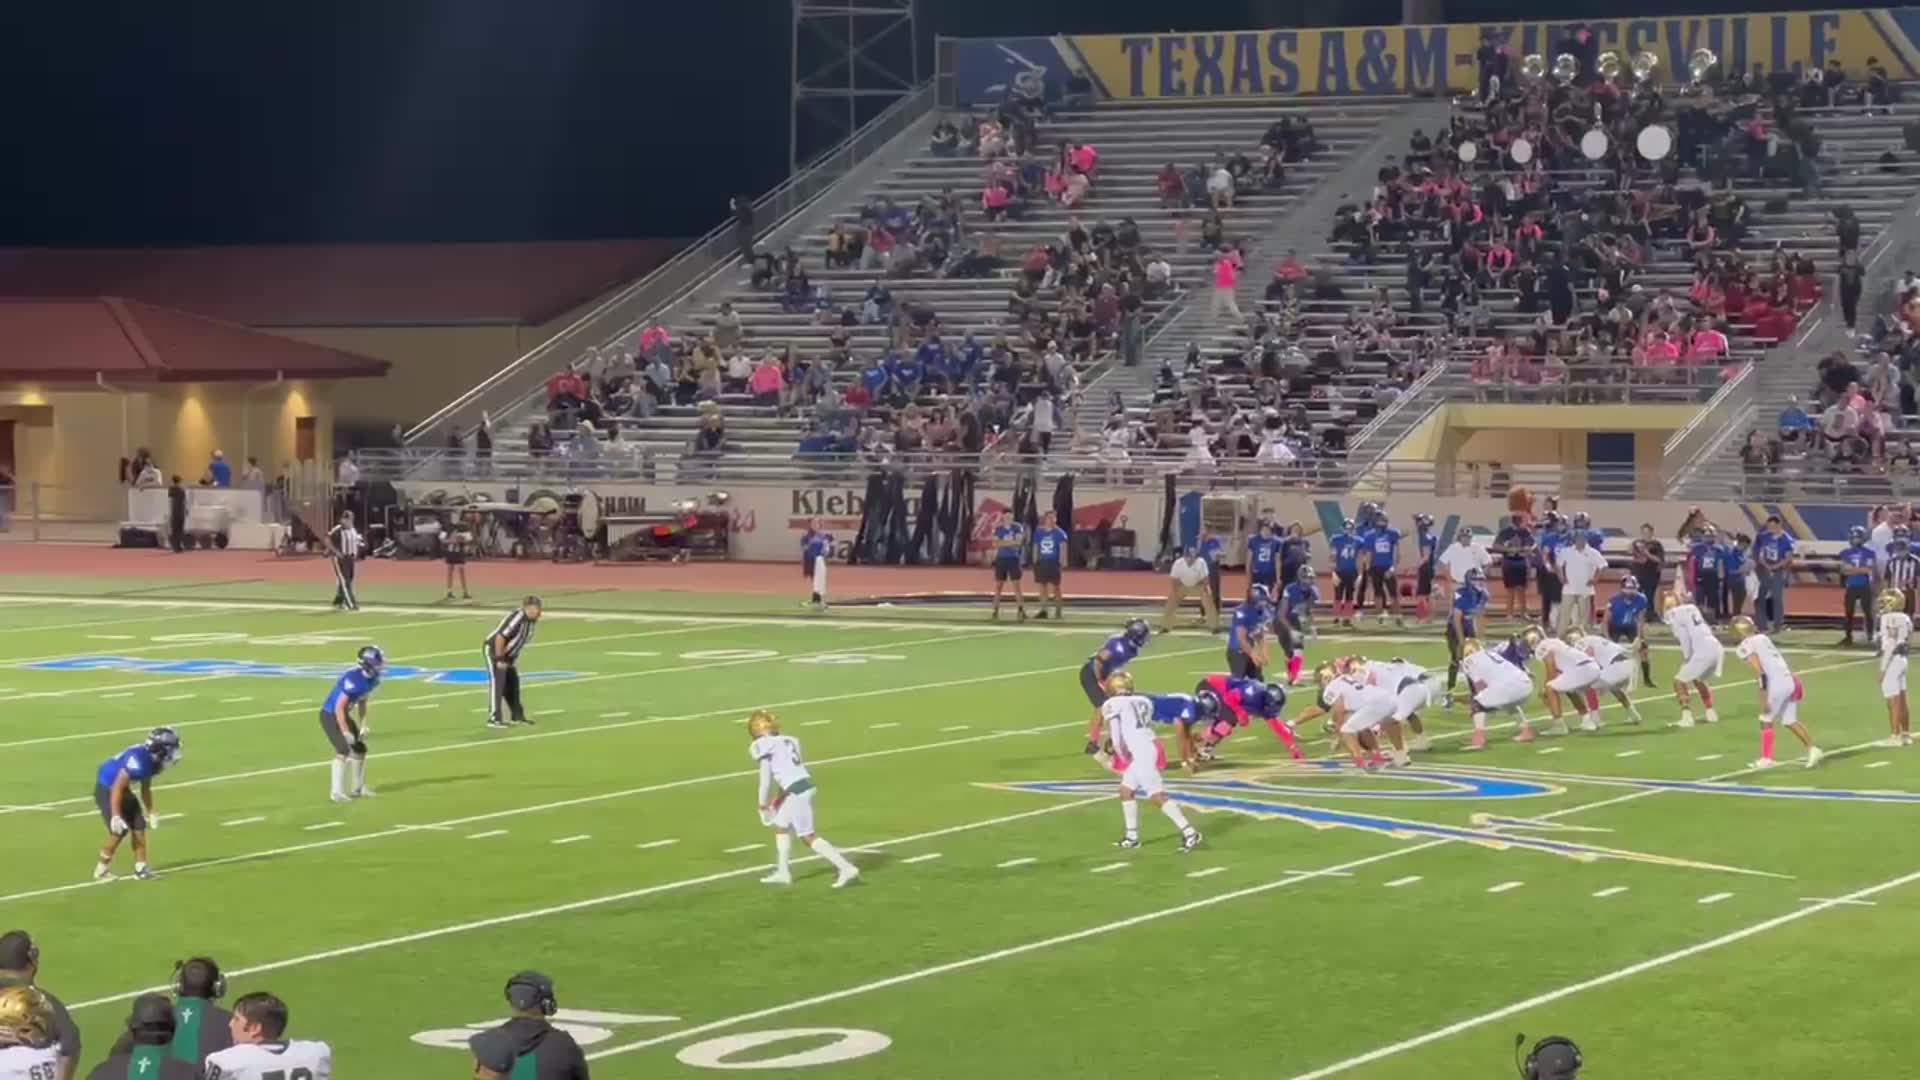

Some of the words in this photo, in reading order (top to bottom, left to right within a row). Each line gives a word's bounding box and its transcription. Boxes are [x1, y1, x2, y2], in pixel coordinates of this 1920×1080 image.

[1120, 32, 1299, 97] TEXAS
[1130, 701, 1152, 729] 12
[784, 738, 801, 766] 3
